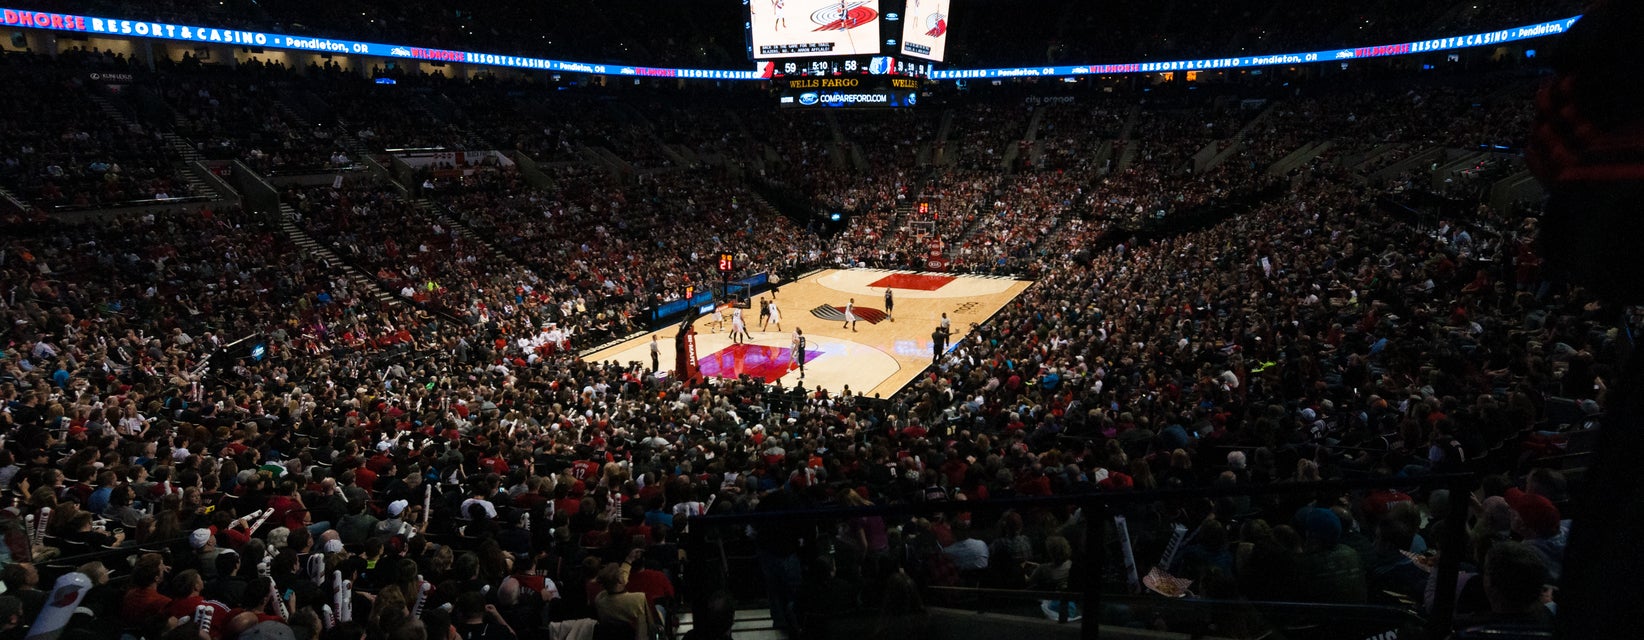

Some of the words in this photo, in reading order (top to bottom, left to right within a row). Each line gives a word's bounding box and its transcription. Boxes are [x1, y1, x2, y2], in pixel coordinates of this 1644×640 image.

[92, 17, 175, 38] RESORT
[181, 27, 192, 39] &
[196, 28, 267, 45] CASINO
[286, 37, 349, 54] Pendleton,
[353, 43, 369, 53] OR
[1354, 43, 1410, 58] WILDHORSE
[1411, 38, 1455, 52] RESORT
[1456, 37, 1464, 47] &
[1466, 30, 1508, 46] CASINO
[1518, 23, 1563, 38] Pendleton,
[410, 48, 465, 62] WILDHORSE
[467, 53, 506, 65] RESORT
[508, 56, 514, 65] &
[515, 57, 551, 69] CASINO
[559, 62, 593, 73] Pendleton,
[595, 65, 606, 73] OR
[812, 61, 828, 70] 5:10
[844, 60, 857, 71] 58
[1090, 64, 1140, 74] WILDHORSE
[1142, 62, 1185, 71] RESORT
[1186, 61, 1194, 69] &
[1196, 57, 1240, 69] CASINO
[1252, 56, 1302, 66] Pendleton,
[1305, 53, 1318, 62] OR
[635, 66, 676, 77] WILDHORSE
[677, 69, 714, 78] RESORT
[715, 70, 722, 78] &
[784, 62, 797, 73] 59
[940, 70, 947, 78] &
[948, 69, 987, 79] CASINO
[997, 68, 1040, 77] Pendleton,
[789, 79, 819, 88] WELLS
[821, 78, 859, 87] FARGO
[891, 79, 915, 88] WELLS
[820, 94, 887, 103] COMPAREFORD.COM
[719, 259, 731, 270] 21
[687, 334, 696, 367] BI-MART
[575, 468, 586, 480] 12
